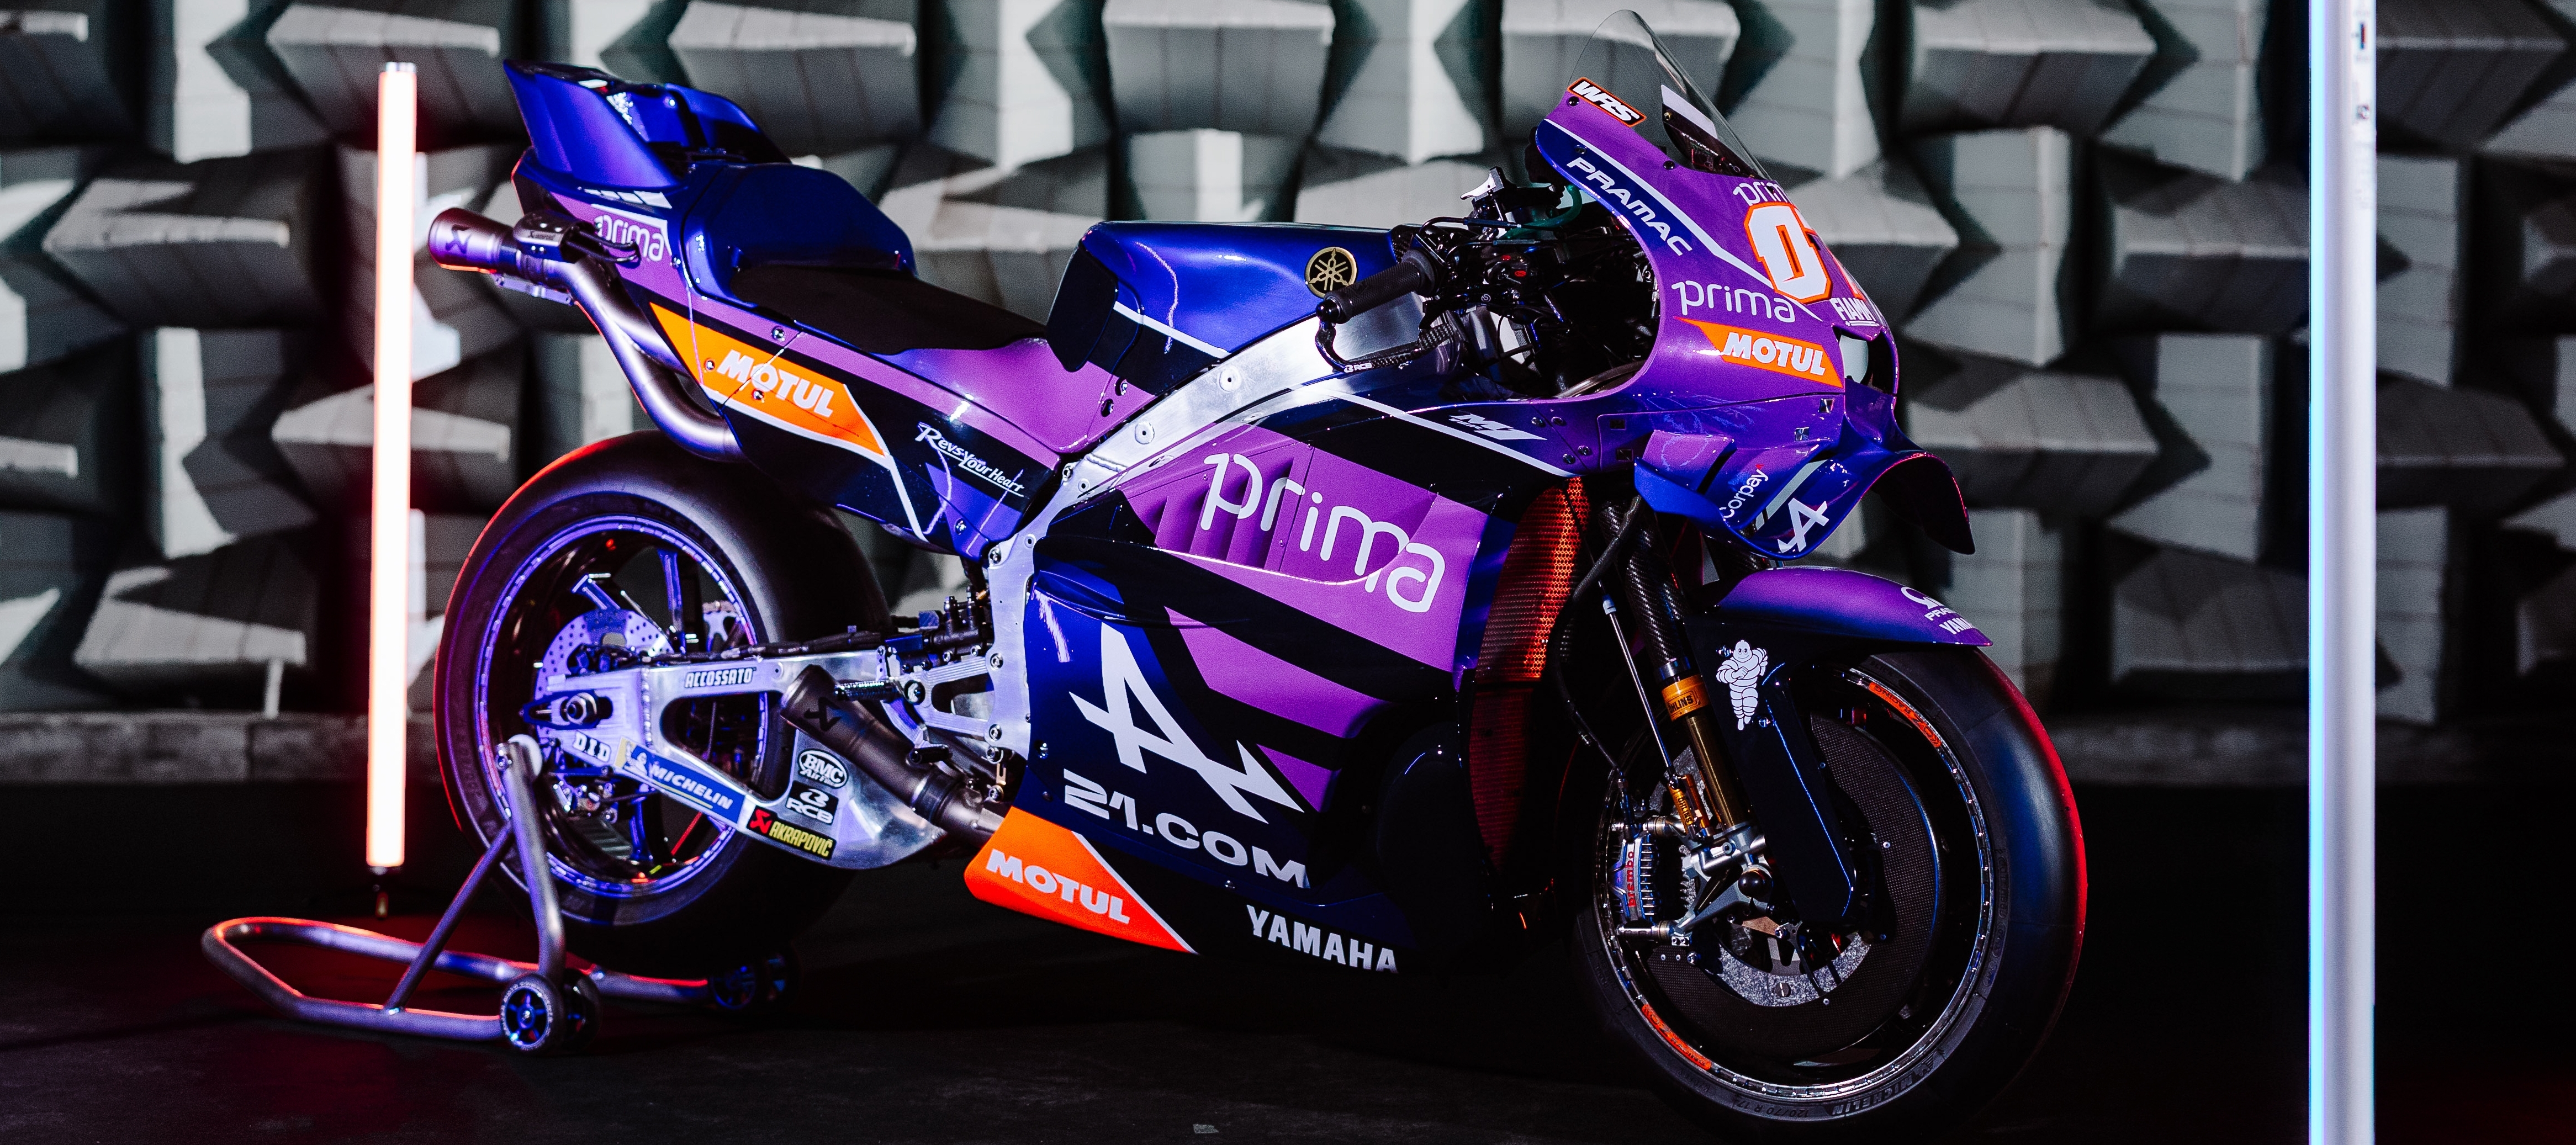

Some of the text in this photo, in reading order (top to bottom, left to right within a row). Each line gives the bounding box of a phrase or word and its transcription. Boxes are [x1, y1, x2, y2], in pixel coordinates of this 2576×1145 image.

[1574, 81, 1639, 121] WRS
[1566, 157, 1692, 256] PRAMAC
[1733, 181, 1788, 206] prim
[1672, 280, 1795, 323] prima
[1723, 332, 1826, 376] MOTUL
[717, 349, 834, 417] MOTUL
[1719, 469, 1768, 518] Corpay
[1200, 453, 1446, 612] prima
[685, 668, 753, 688] ACCOSSATO
[649, 762, 733, 810] MICHELIN
[803, 754, 843, 783] BMC
[786, 797, 834, 824] RCB
[986, 849, 1130, 924] MOTUL
[1626, 851, 1637, 907] brembo
[1246, 904, 1399, 973] YAMAHA
